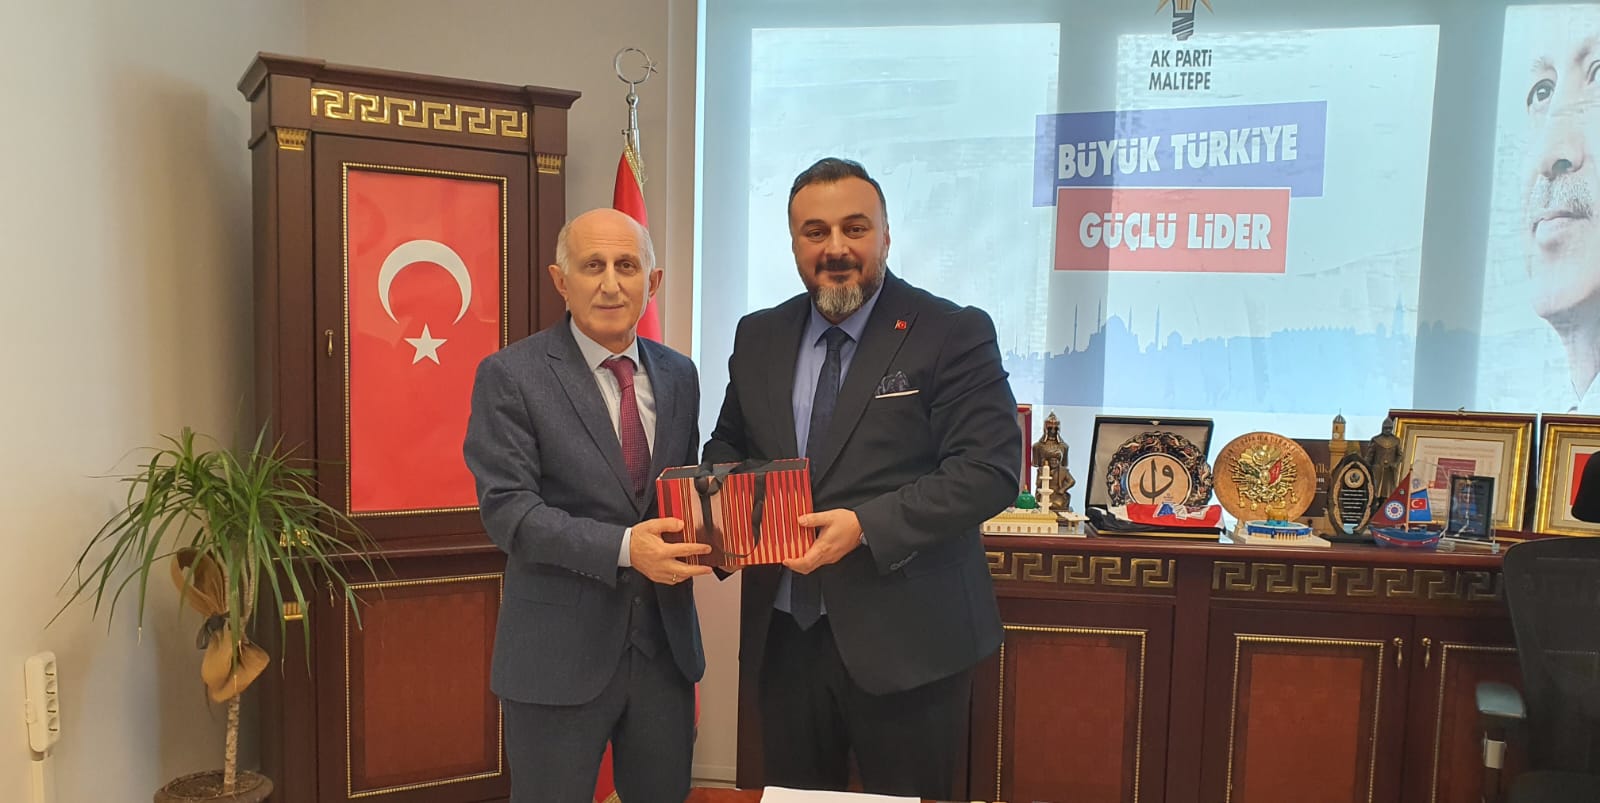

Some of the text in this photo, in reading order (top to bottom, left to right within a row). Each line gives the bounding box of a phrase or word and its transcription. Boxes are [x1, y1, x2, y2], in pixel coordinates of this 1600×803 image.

[1150, 49, 1171, 67] AK
[1149, 71, 1211, 90] MALTEPE
[1058, 135, 1160, 180] BÜYÜK
[1079, 212, 1177, 251] GÜÇLÜ
